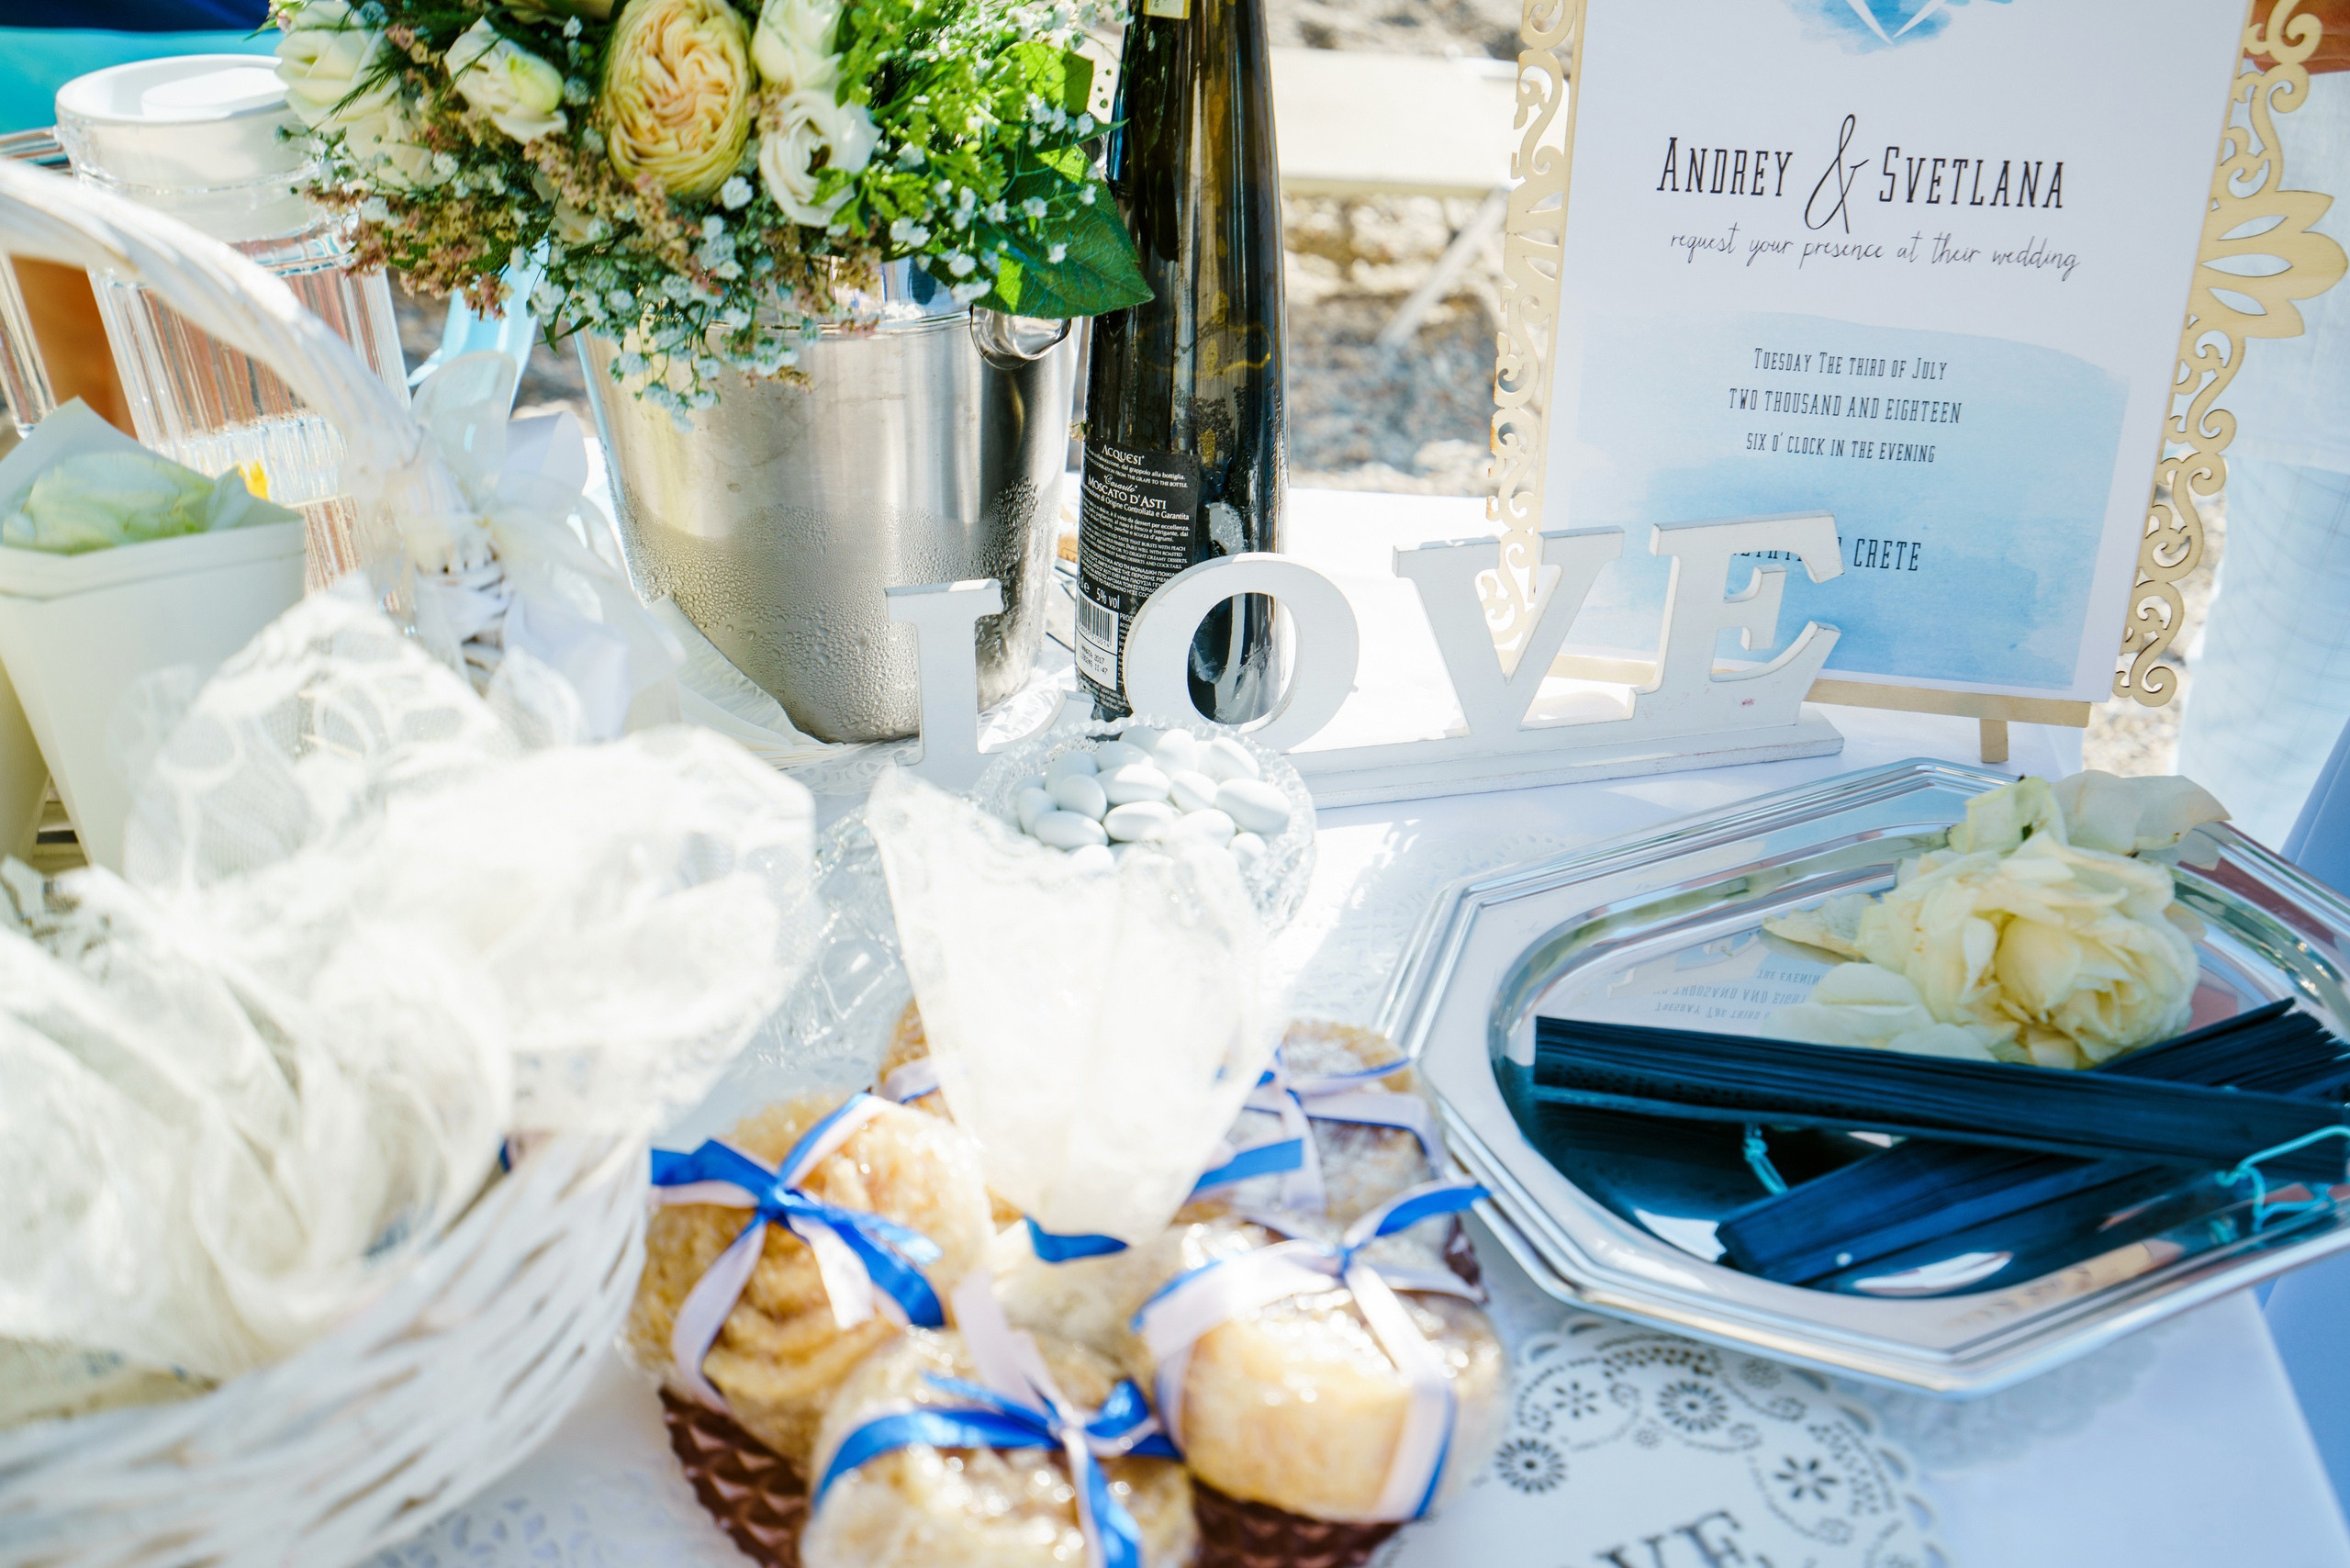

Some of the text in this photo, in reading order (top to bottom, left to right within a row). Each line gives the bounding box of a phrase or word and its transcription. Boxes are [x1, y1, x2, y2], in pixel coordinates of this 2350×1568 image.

[1657, 114, 2064, 234] ANDREY & SVETLANA
[1671, 222, 2081, 282] request your presence at their wedding
[1754, 348, 1948, 380] TUESDAY THE THIRD OF JULY
[1729, 388, 1962, 424] TWO THOUSAND AND EIGHTEEN
[1746, 432, 1767, 451] SIX
[1830, 439, 1845, 457] IN
[1852, 441, 1874, 459] THE
[1878, 442, 1936, 463] EVENING
[1088, 474, 1126, 502] MOSCATO
[1129, 493, 1167, 510] D'ASTI
[1105, 496, 1122, 510] Origine
[1124, 502, 1154, 516] Controllata
[1160, 510, 1189, 520] Garantita
[1852, 538, 1921, 571] CRETE
[1096, 588, 1107, 605] 5%
[1109, 594, 1120, 610] vol
[885, 509, 1845, 790] LOVE
